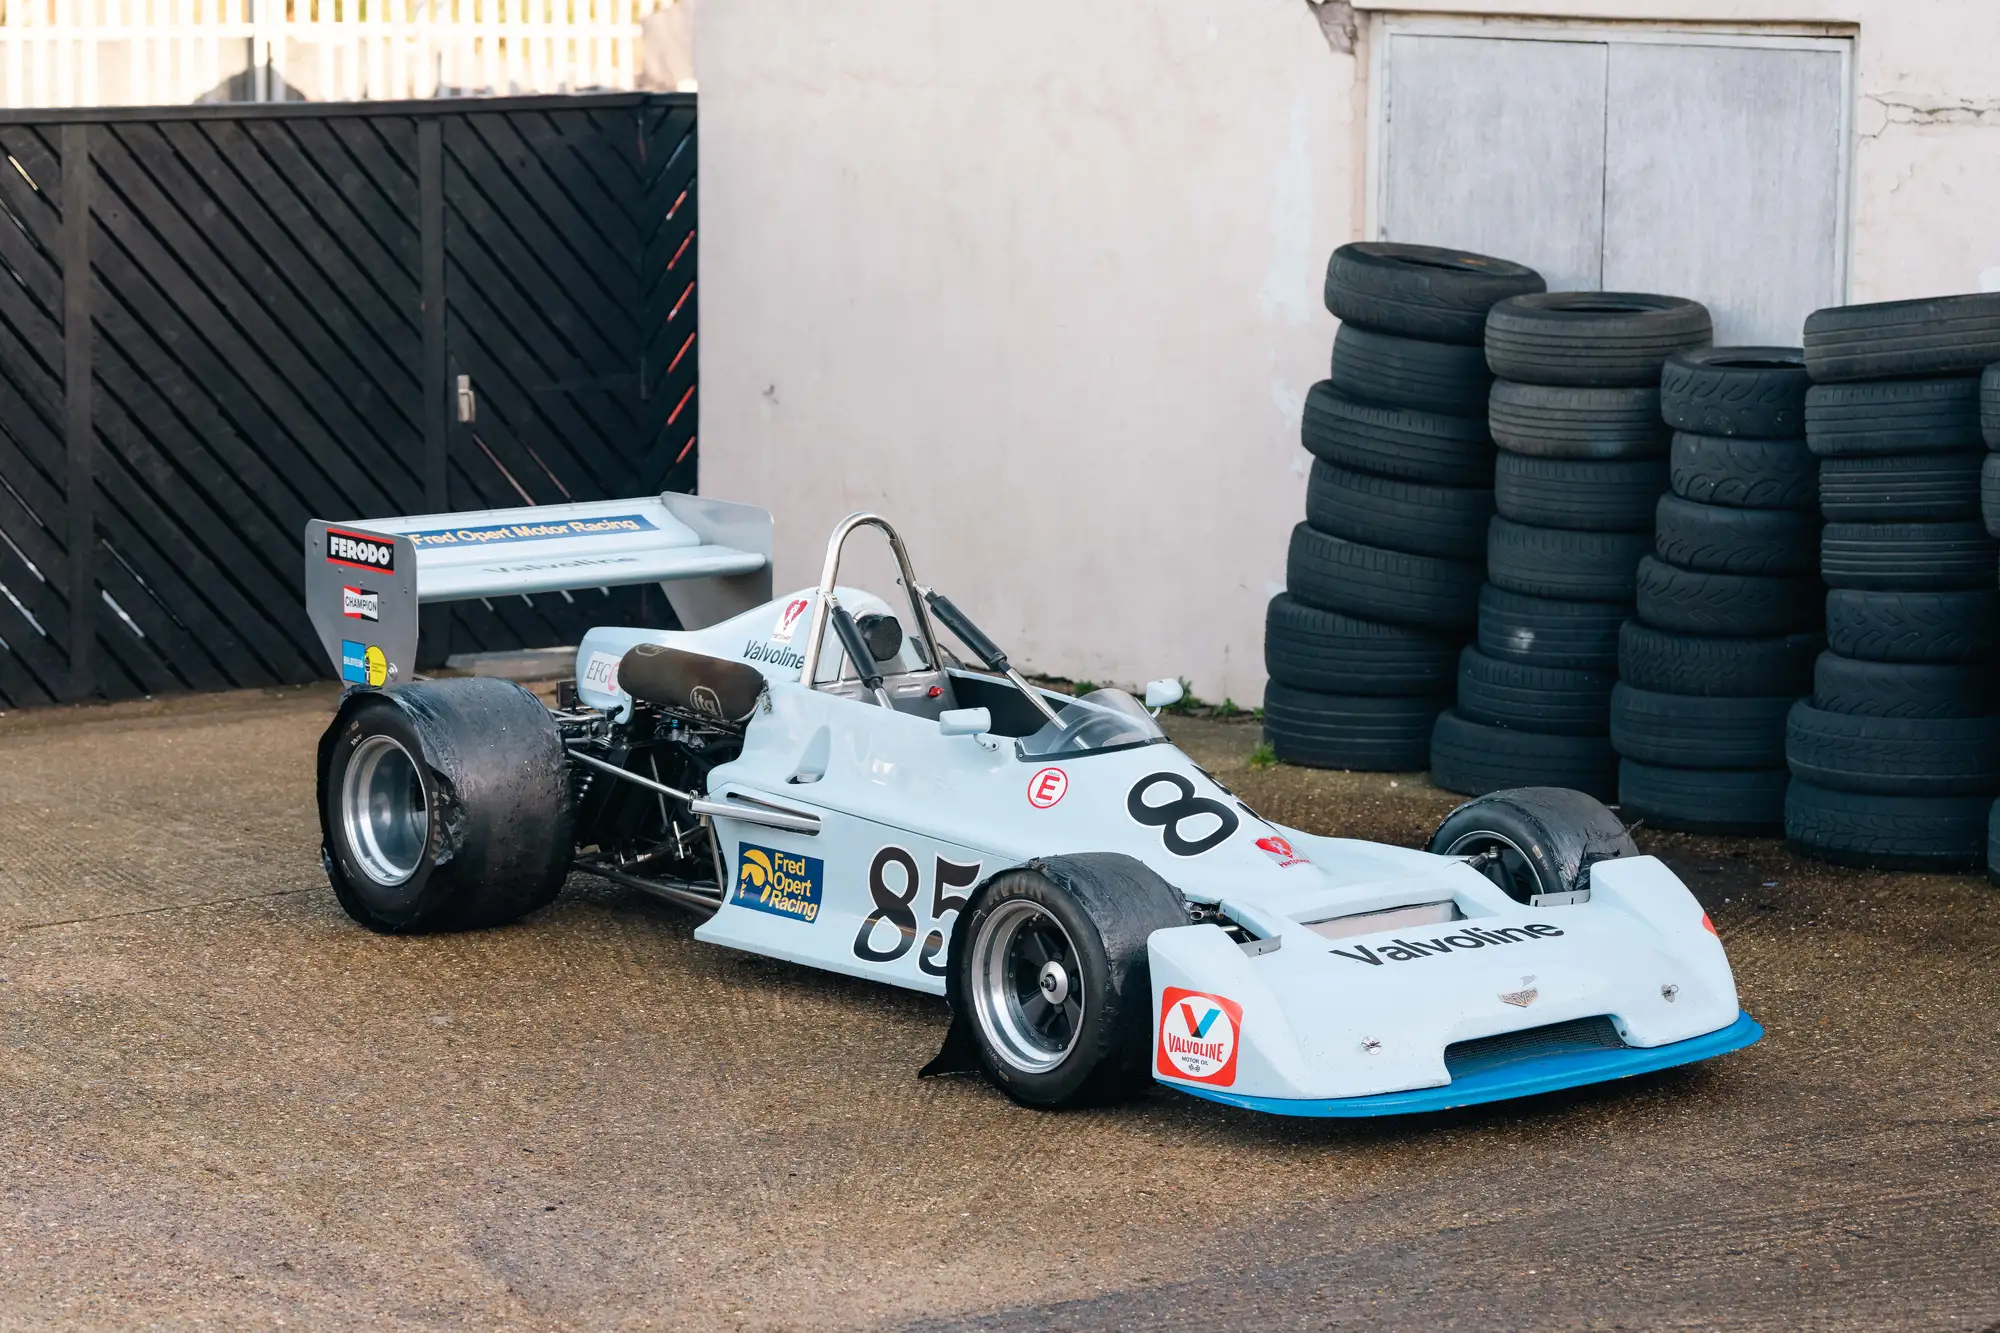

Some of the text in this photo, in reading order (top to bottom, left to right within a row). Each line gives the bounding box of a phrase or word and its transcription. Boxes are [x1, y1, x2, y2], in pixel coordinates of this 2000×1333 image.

[408, 518, 641, 546] Fred Opert Motor Racing
[330, 536, 390, 566] FERODO
[482, 557, 640, 575] Valvoline
[345, 596, 377, 613] CHAMPION
[743, 639, 805, 670] Valvoline
[1035, 774, 1061, 801] E
[1127, 764, 1280, 857] 8
[774, 852, 805, 876] Fred
[773, 871, 811, 897] Opert
[768, 889, 818, 922] Racing
[854, 846, 982, 977] 85
[1329, 923, 1565, 967] Valvoline
[1168, 1032, 1224, 1063] VALVOLINE
[1181, 1055, 1200, 1065] MOTOR
